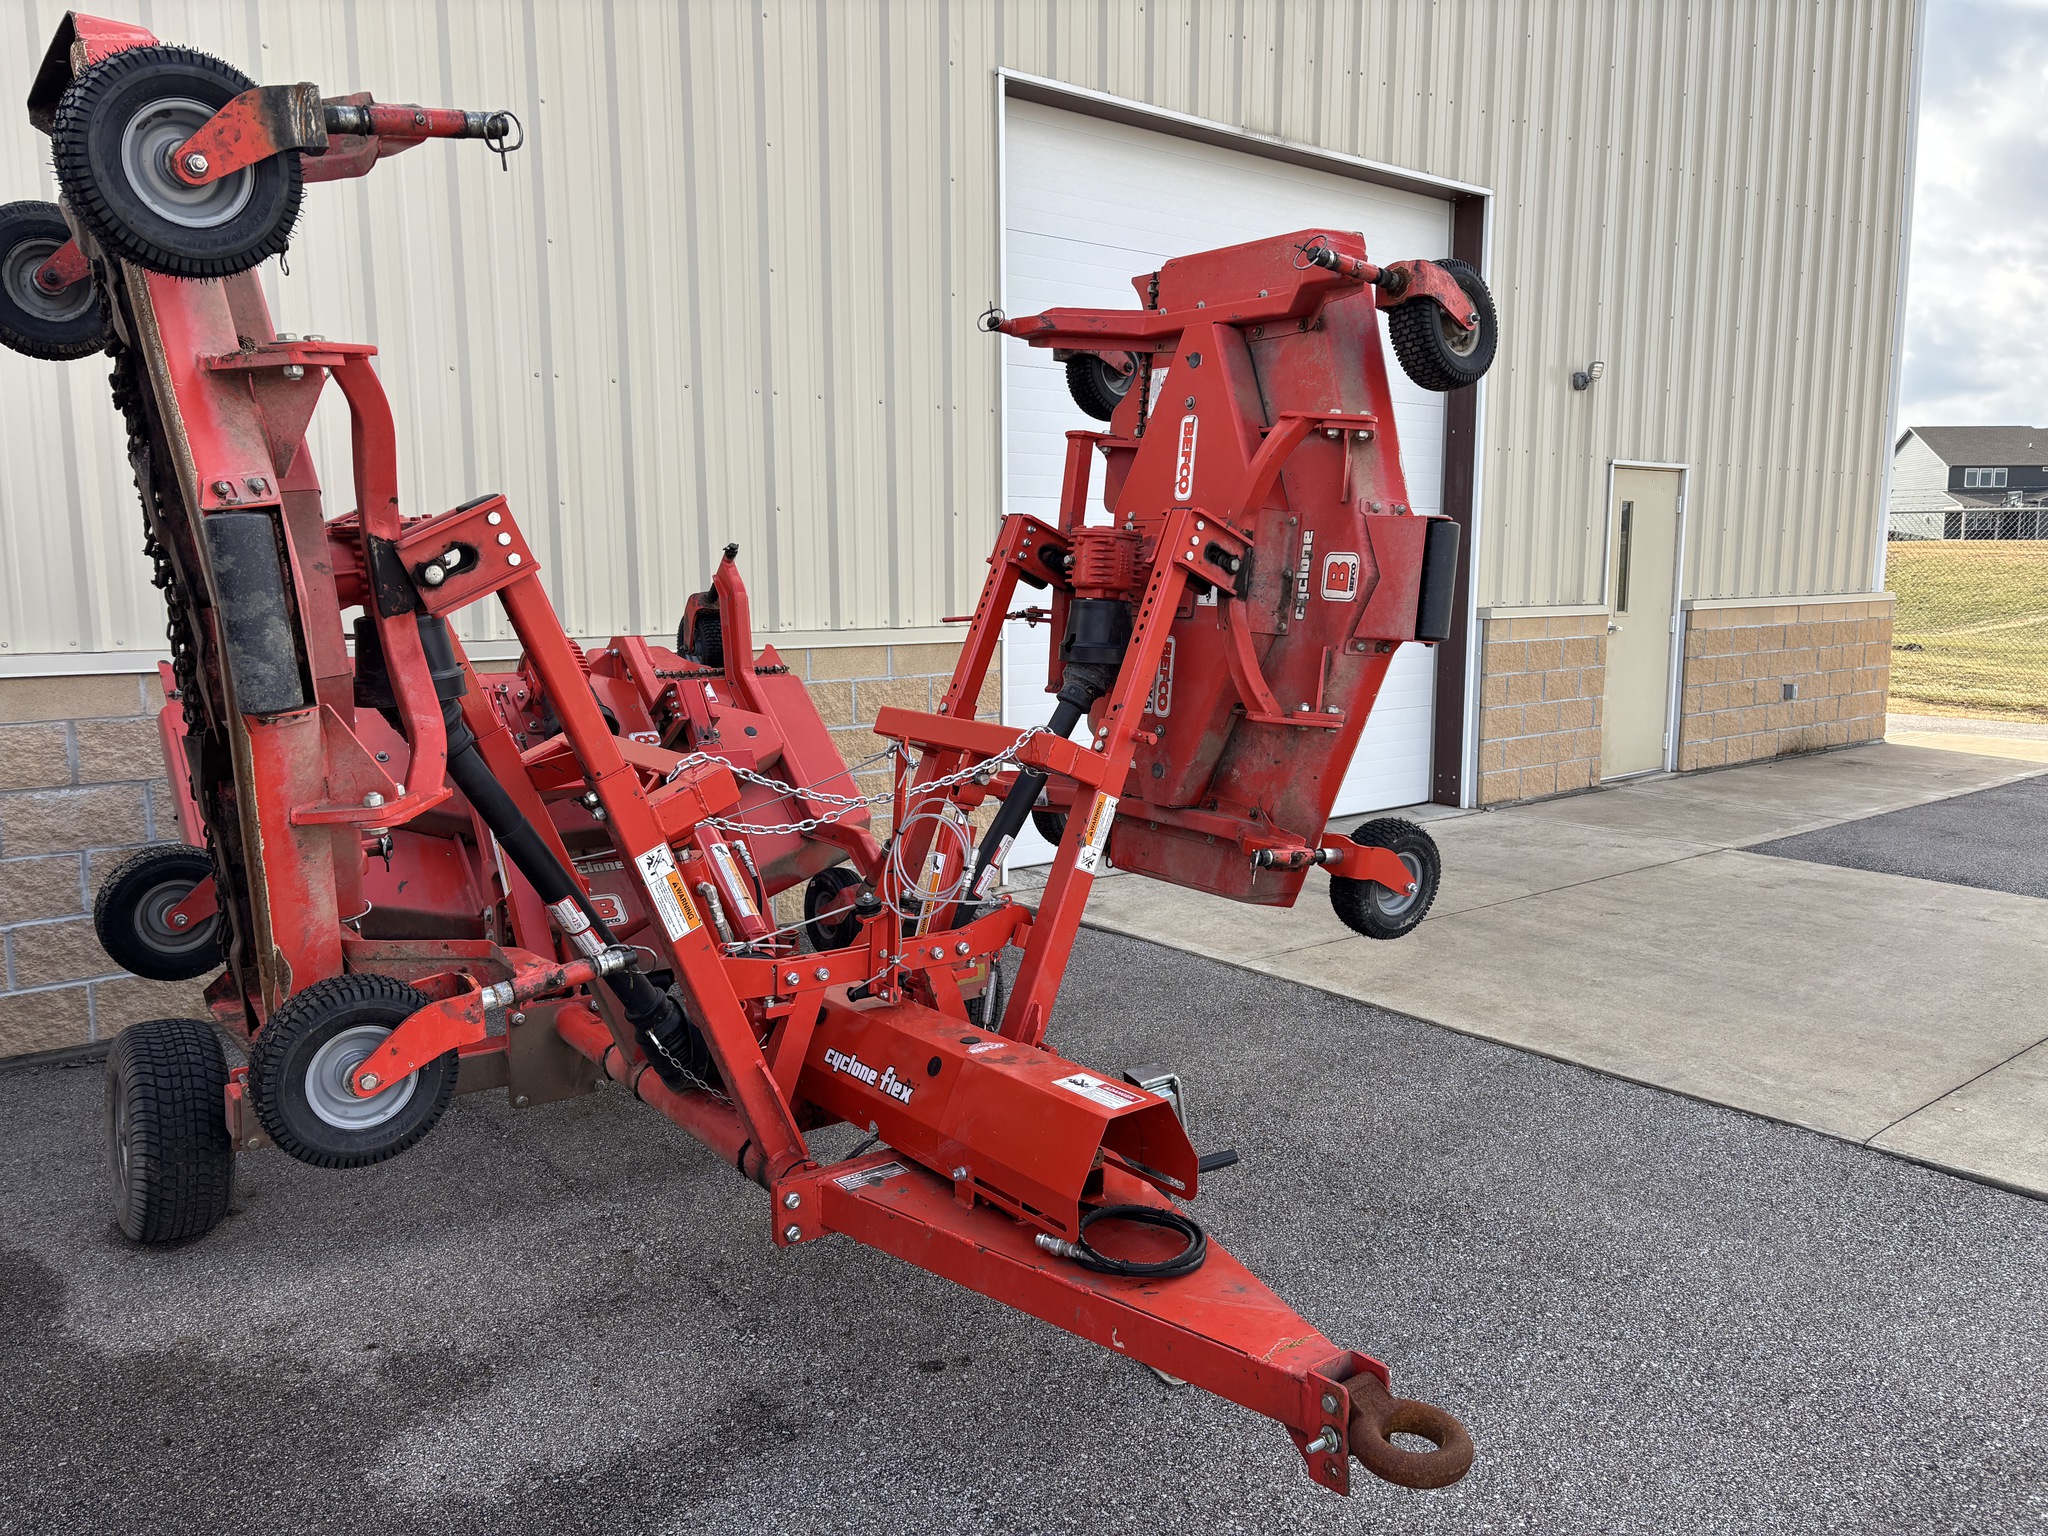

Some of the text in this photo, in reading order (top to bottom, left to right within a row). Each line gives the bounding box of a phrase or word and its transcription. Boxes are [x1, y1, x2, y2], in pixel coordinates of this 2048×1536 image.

[1176, 421, 1195, 495] BEFCO
[1294, 529, 1314, 621] cyclone
[1326, 561, 1351, 592] B
[1347, 562, 1357, 592] BEFCO
[1157, 641, 1172, 711] BEFCO
[1090, 801, 1103, 831] WARNING
[576, 860, 625, 875] clone
[675, 888, 695, 920] WARNING
[823, 1048, 915, 1106] cyclone flex
